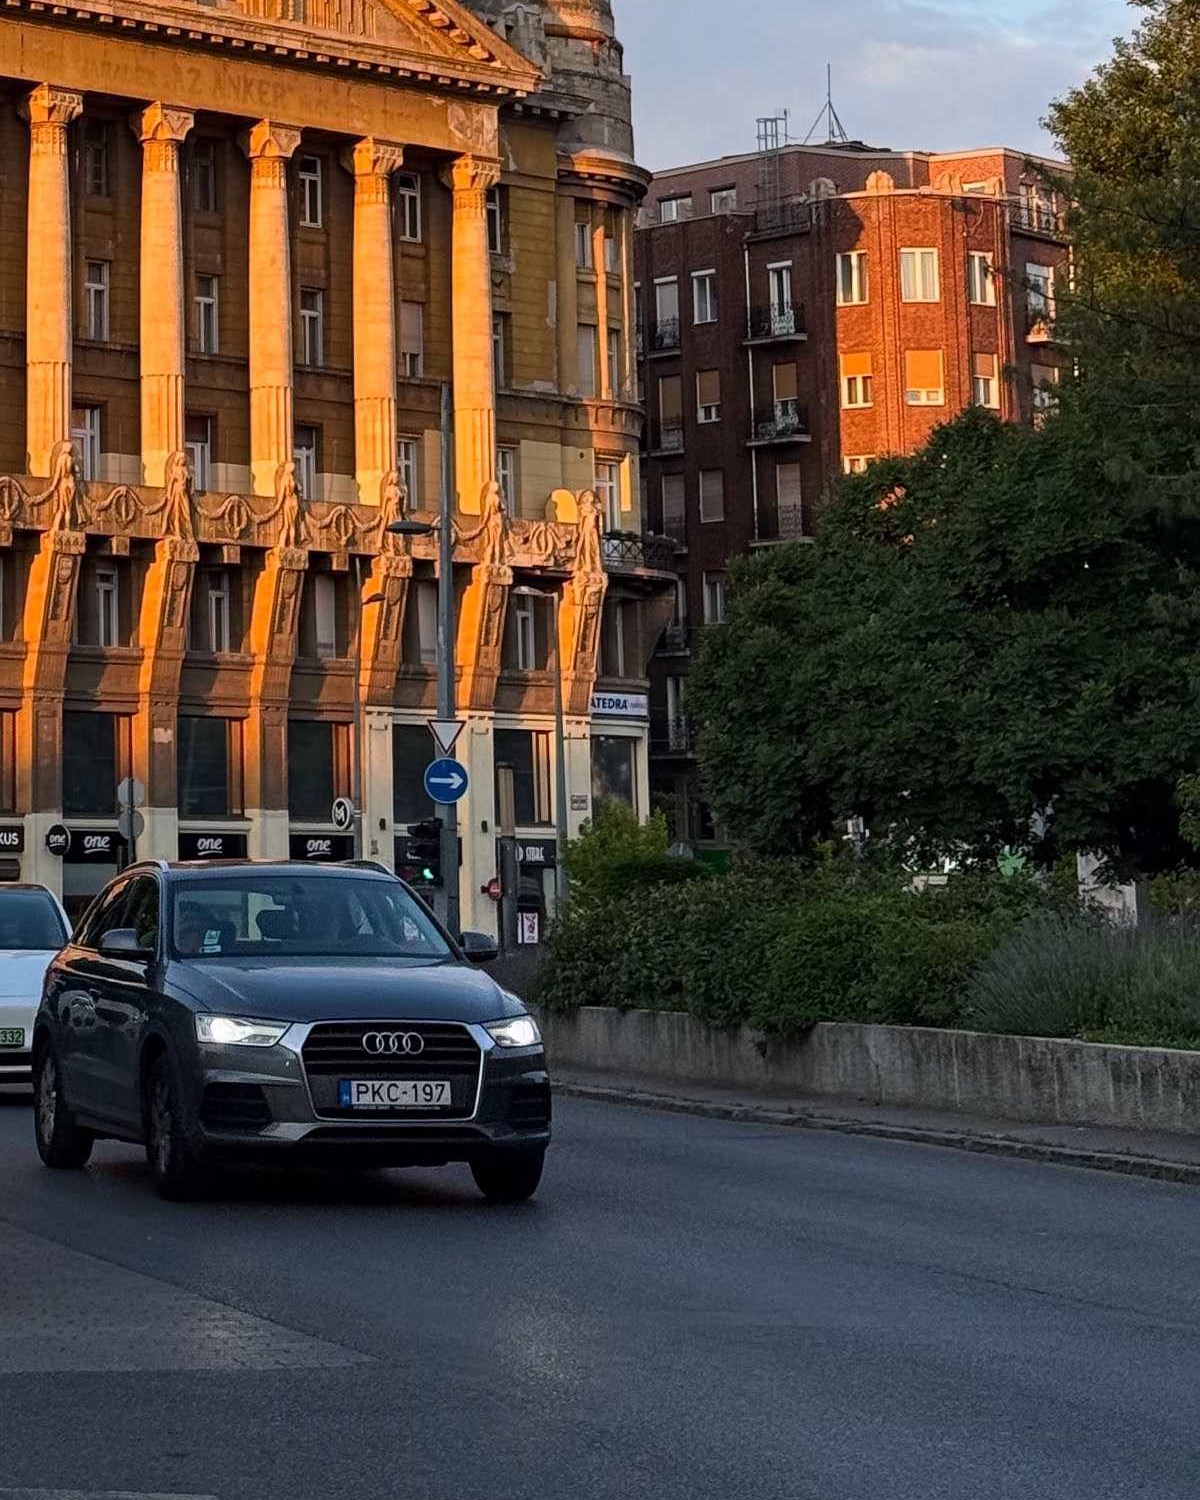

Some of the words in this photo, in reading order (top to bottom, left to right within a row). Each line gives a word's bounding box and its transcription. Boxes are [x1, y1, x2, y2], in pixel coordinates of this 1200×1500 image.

[591, 696, 628, 710] ATEDRA
[50, 834, 66, 843] one
[83, 835, 110, 848] one
[196, 838, 222, 850] one
[306, 839, 331, 851] one
[356, 1083, 445, 1102] PKC-197
